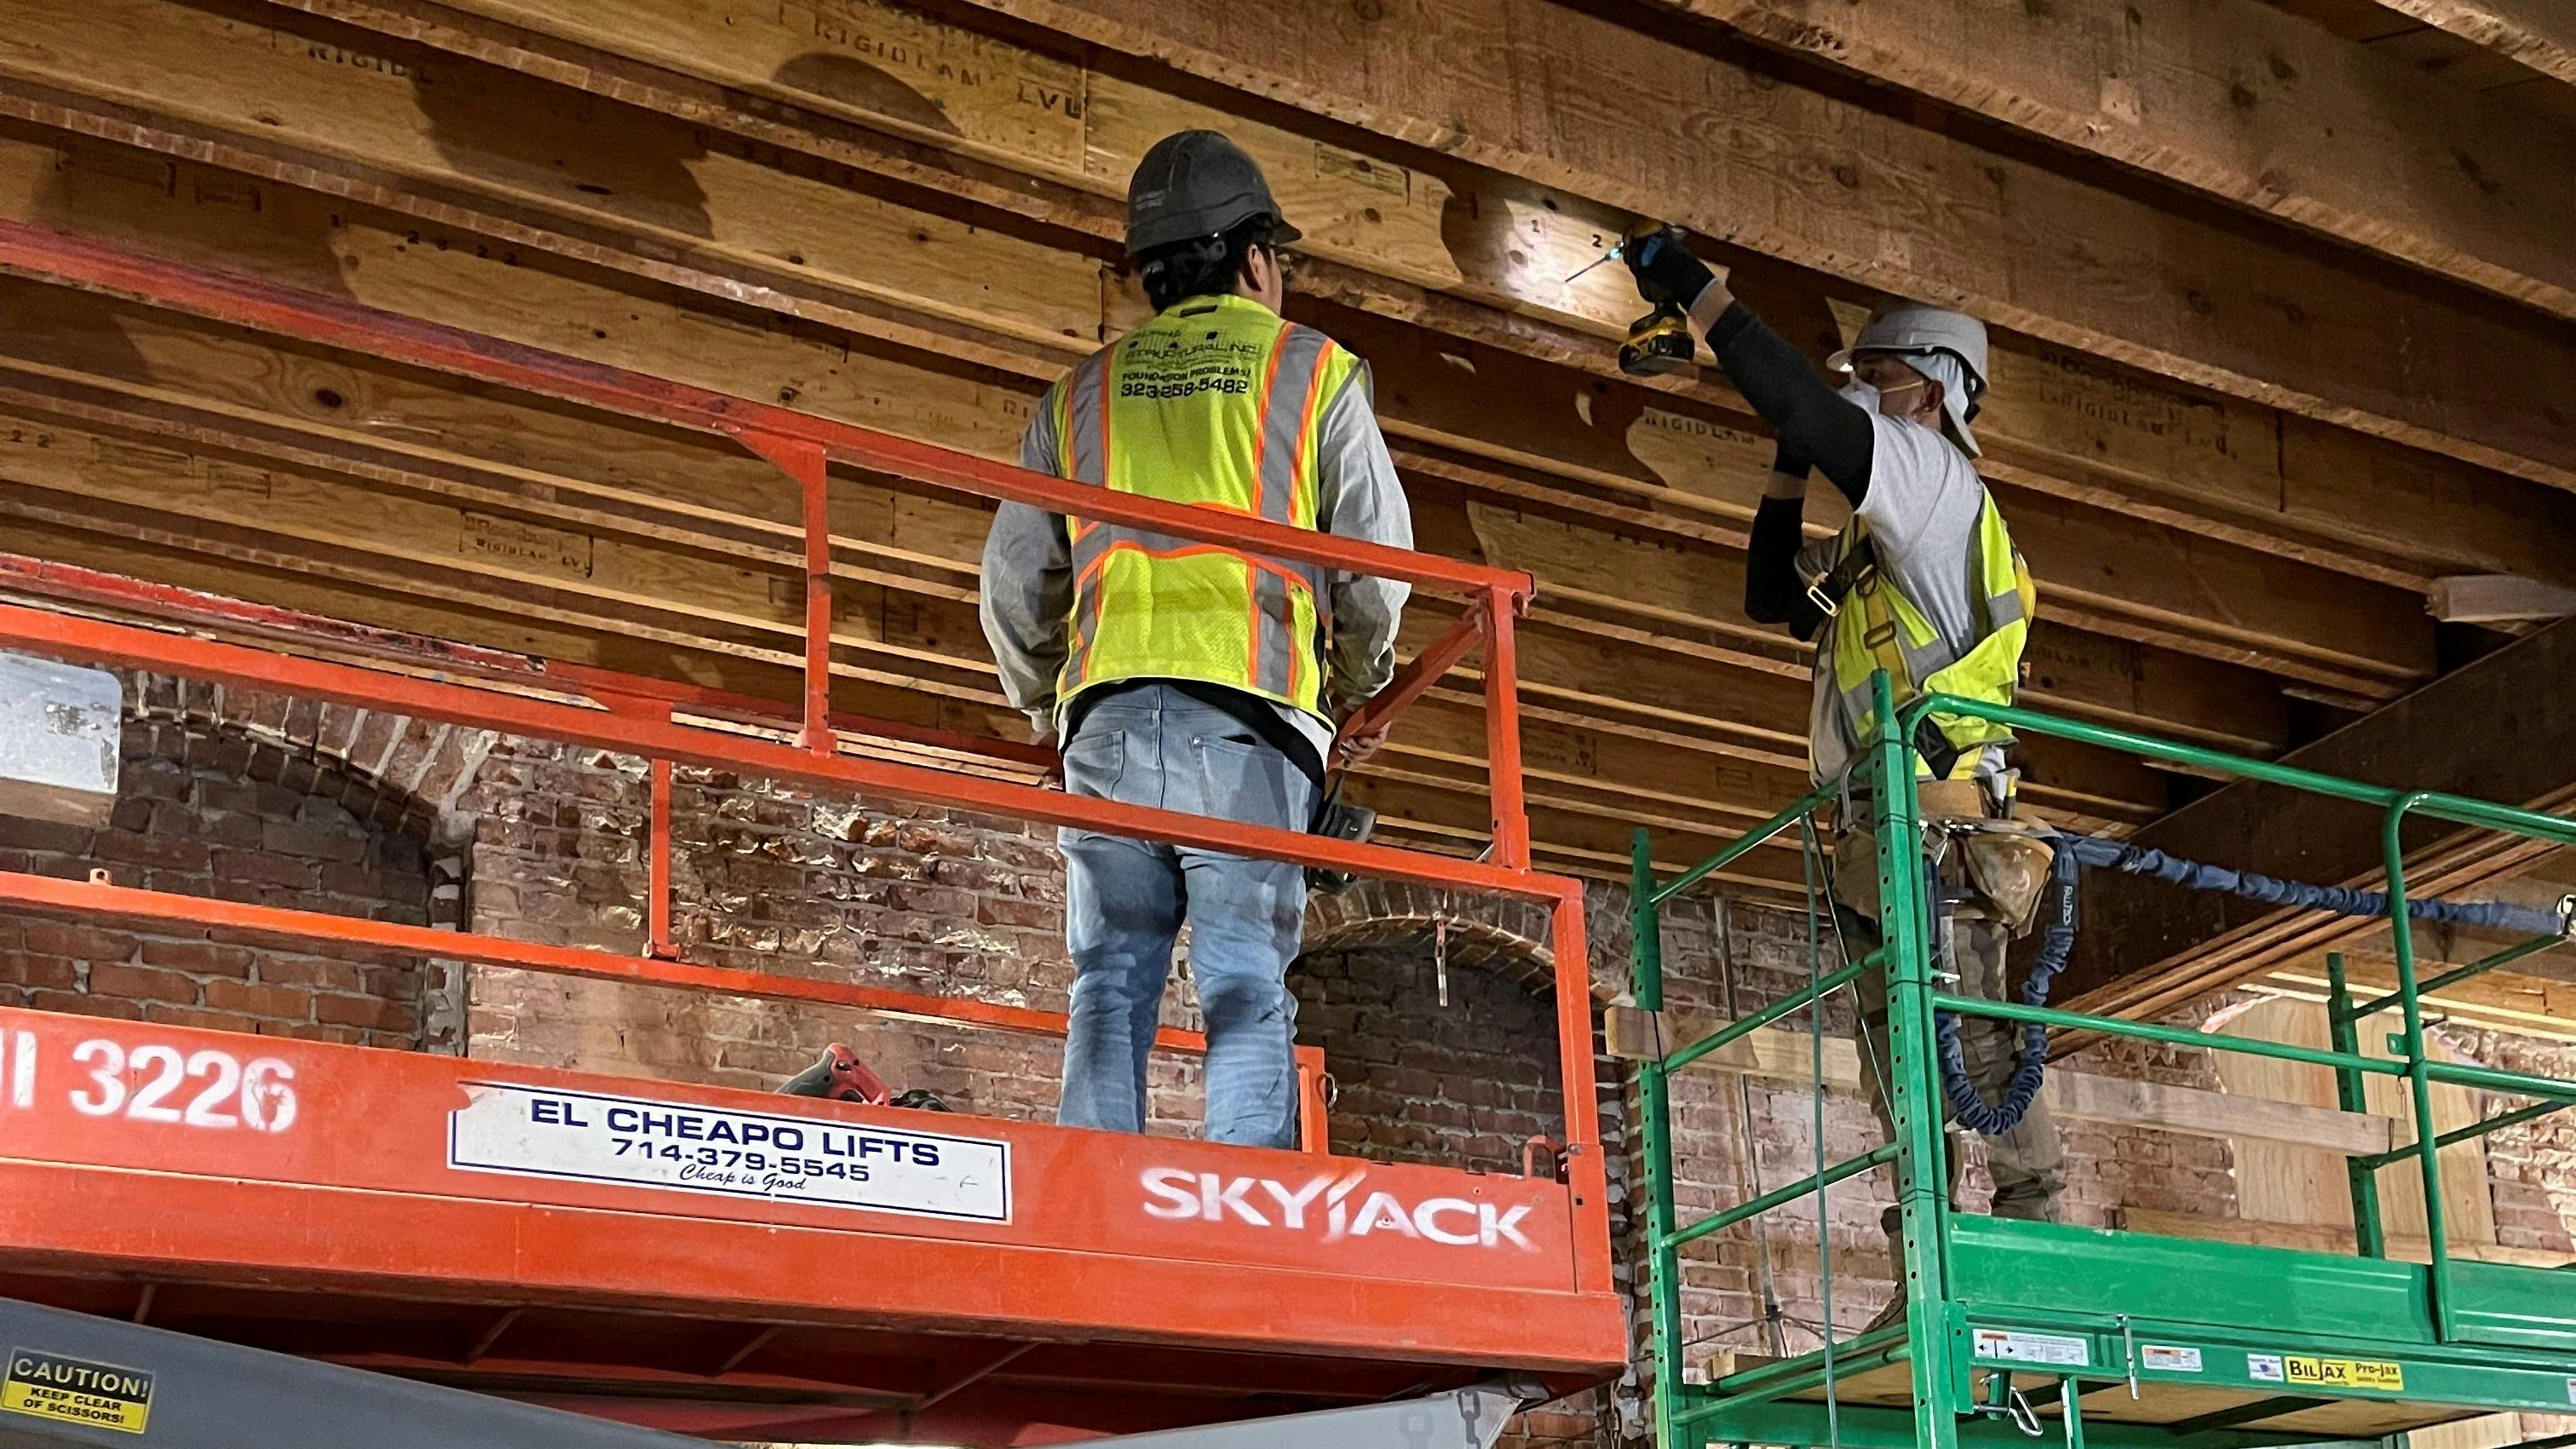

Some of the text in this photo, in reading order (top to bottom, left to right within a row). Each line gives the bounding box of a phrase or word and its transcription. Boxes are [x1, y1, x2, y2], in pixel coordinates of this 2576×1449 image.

[1591, 233, 1602, 248] 2
[69, 1038, 298, 1134] 3226
[531, 1098, 940, 1167] EL CHEAPO LIFTS
[610, 1137, 871, 1182] 714-379-5545
[679, 1163, 808, 1193] Cheap is Good
[1140, 1167, 1540, 1253] SKYJACK
[14, 1357, 149, 1398] CAUTION!
[23, 1398, 125, 1424] OF SCISSORS!
[30, 1387, 123, 1412] KEEP CLEAR
